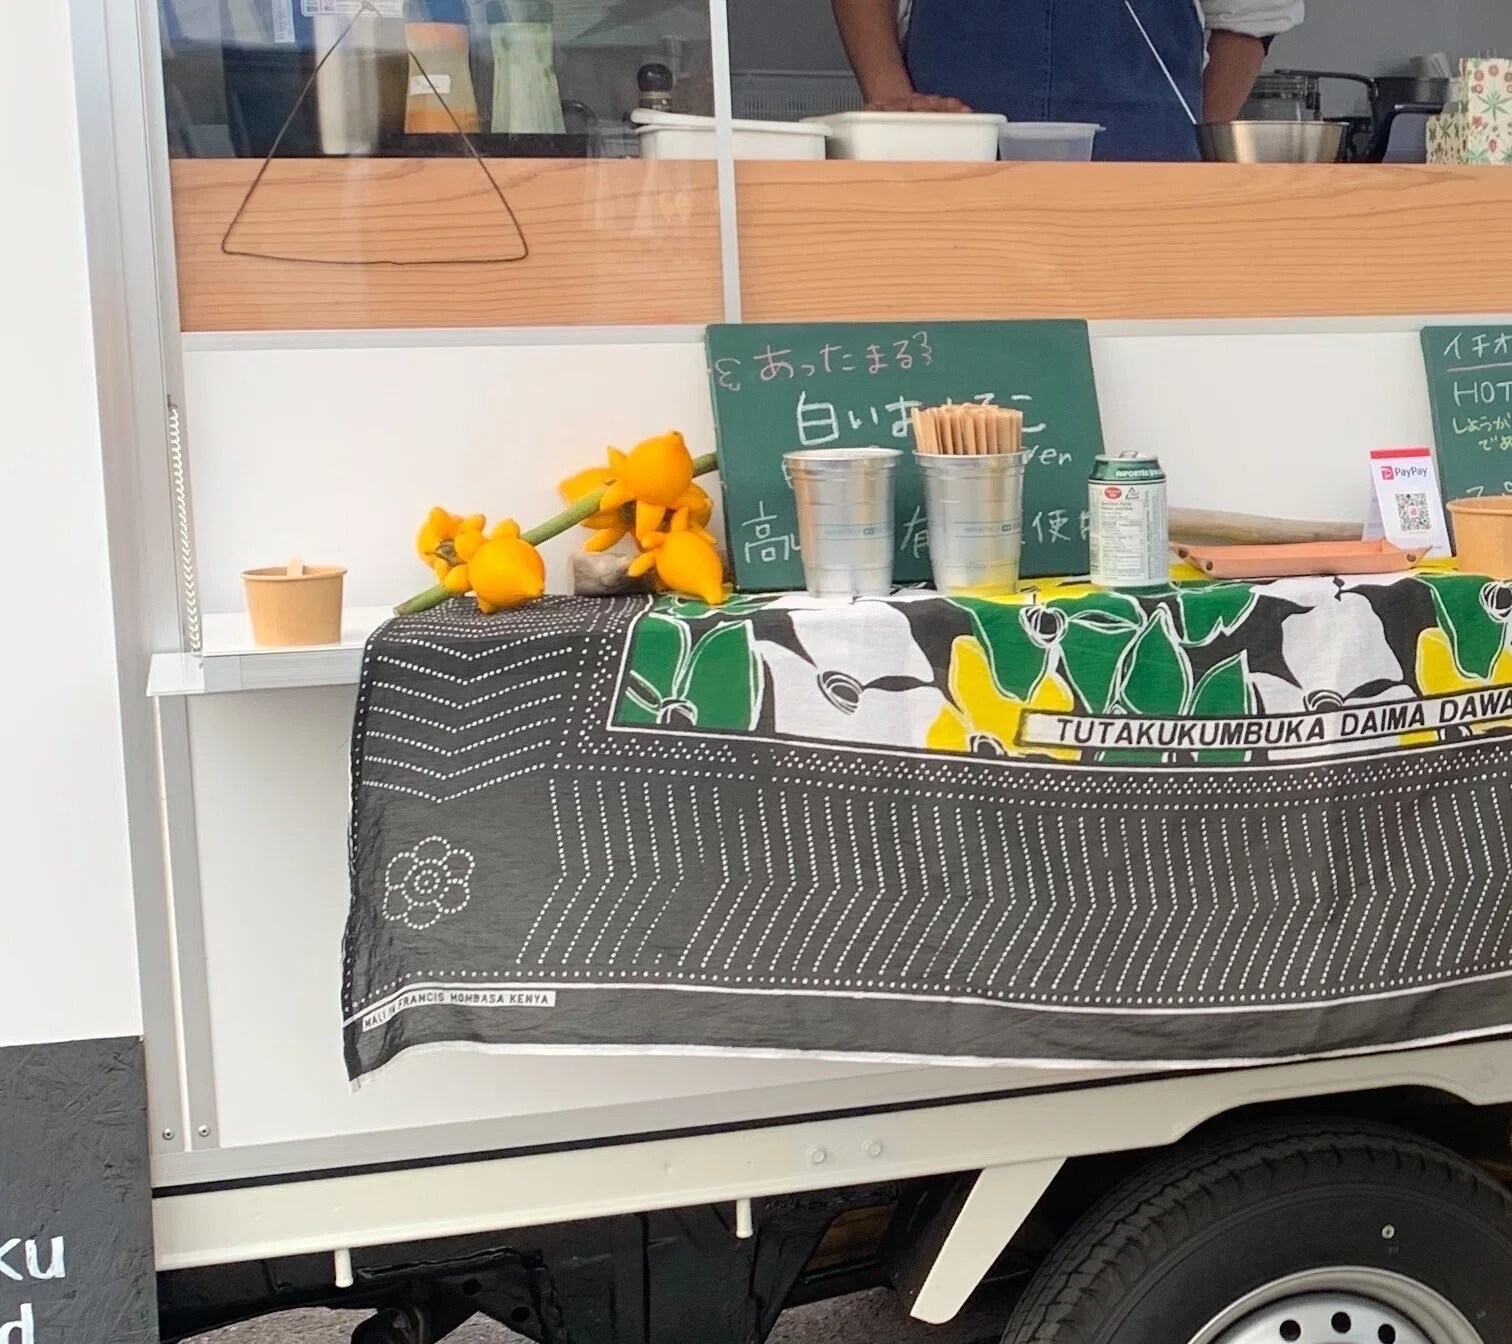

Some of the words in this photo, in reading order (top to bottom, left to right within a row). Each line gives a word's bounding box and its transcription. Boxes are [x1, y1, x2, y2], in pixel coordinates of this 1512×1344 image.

[753, 341, 916, 381] あったまる
[1394, 467, 1428, 478] PayPay
[1056, 715, 1325, 746] TUTAKUKUMBUKA
[1339, 699, 1426, 738] DAIMA
[450, 992, 505, 1004] MOMBASA
[509, 992, 549, 1004] KENYA
